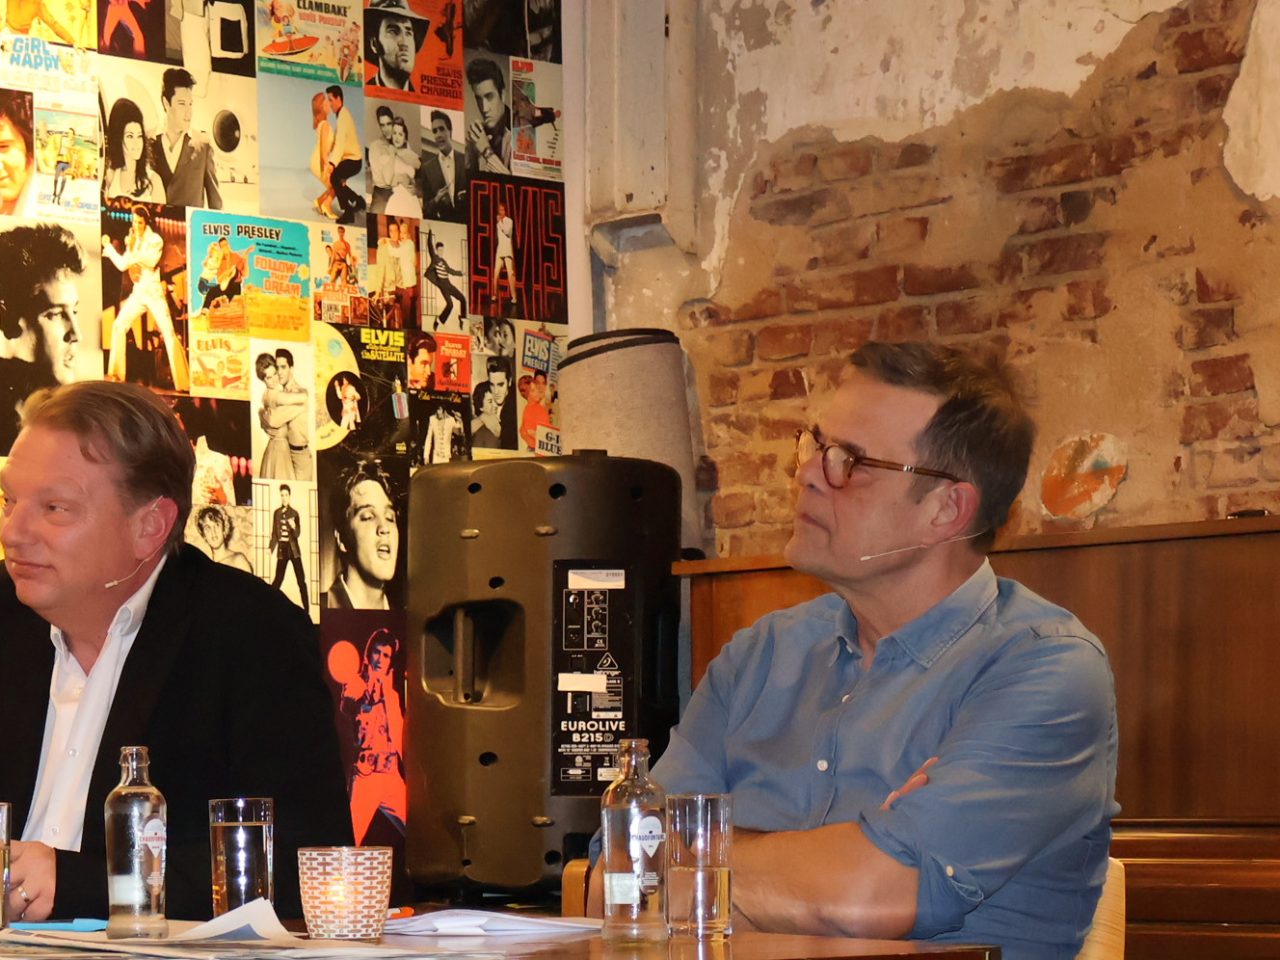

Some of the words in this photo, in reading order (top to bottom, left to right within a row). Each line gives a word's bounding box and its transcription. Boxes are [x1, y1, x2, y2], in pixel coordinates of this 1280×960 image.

[296, 0, 348, 17] CLAMBAKE
[202, 224, 231, 236] ELVIS
[236, 224, 282, 241] PRESLEY
[470, 181, 564, 292] ELVIS
[361, 328, 405, 347] ELVIS
[524, 335, 550, 362] ELVIS
[560, 720, 626, 732] EUROLIVE
[572, 733, 614, 743] B215D
